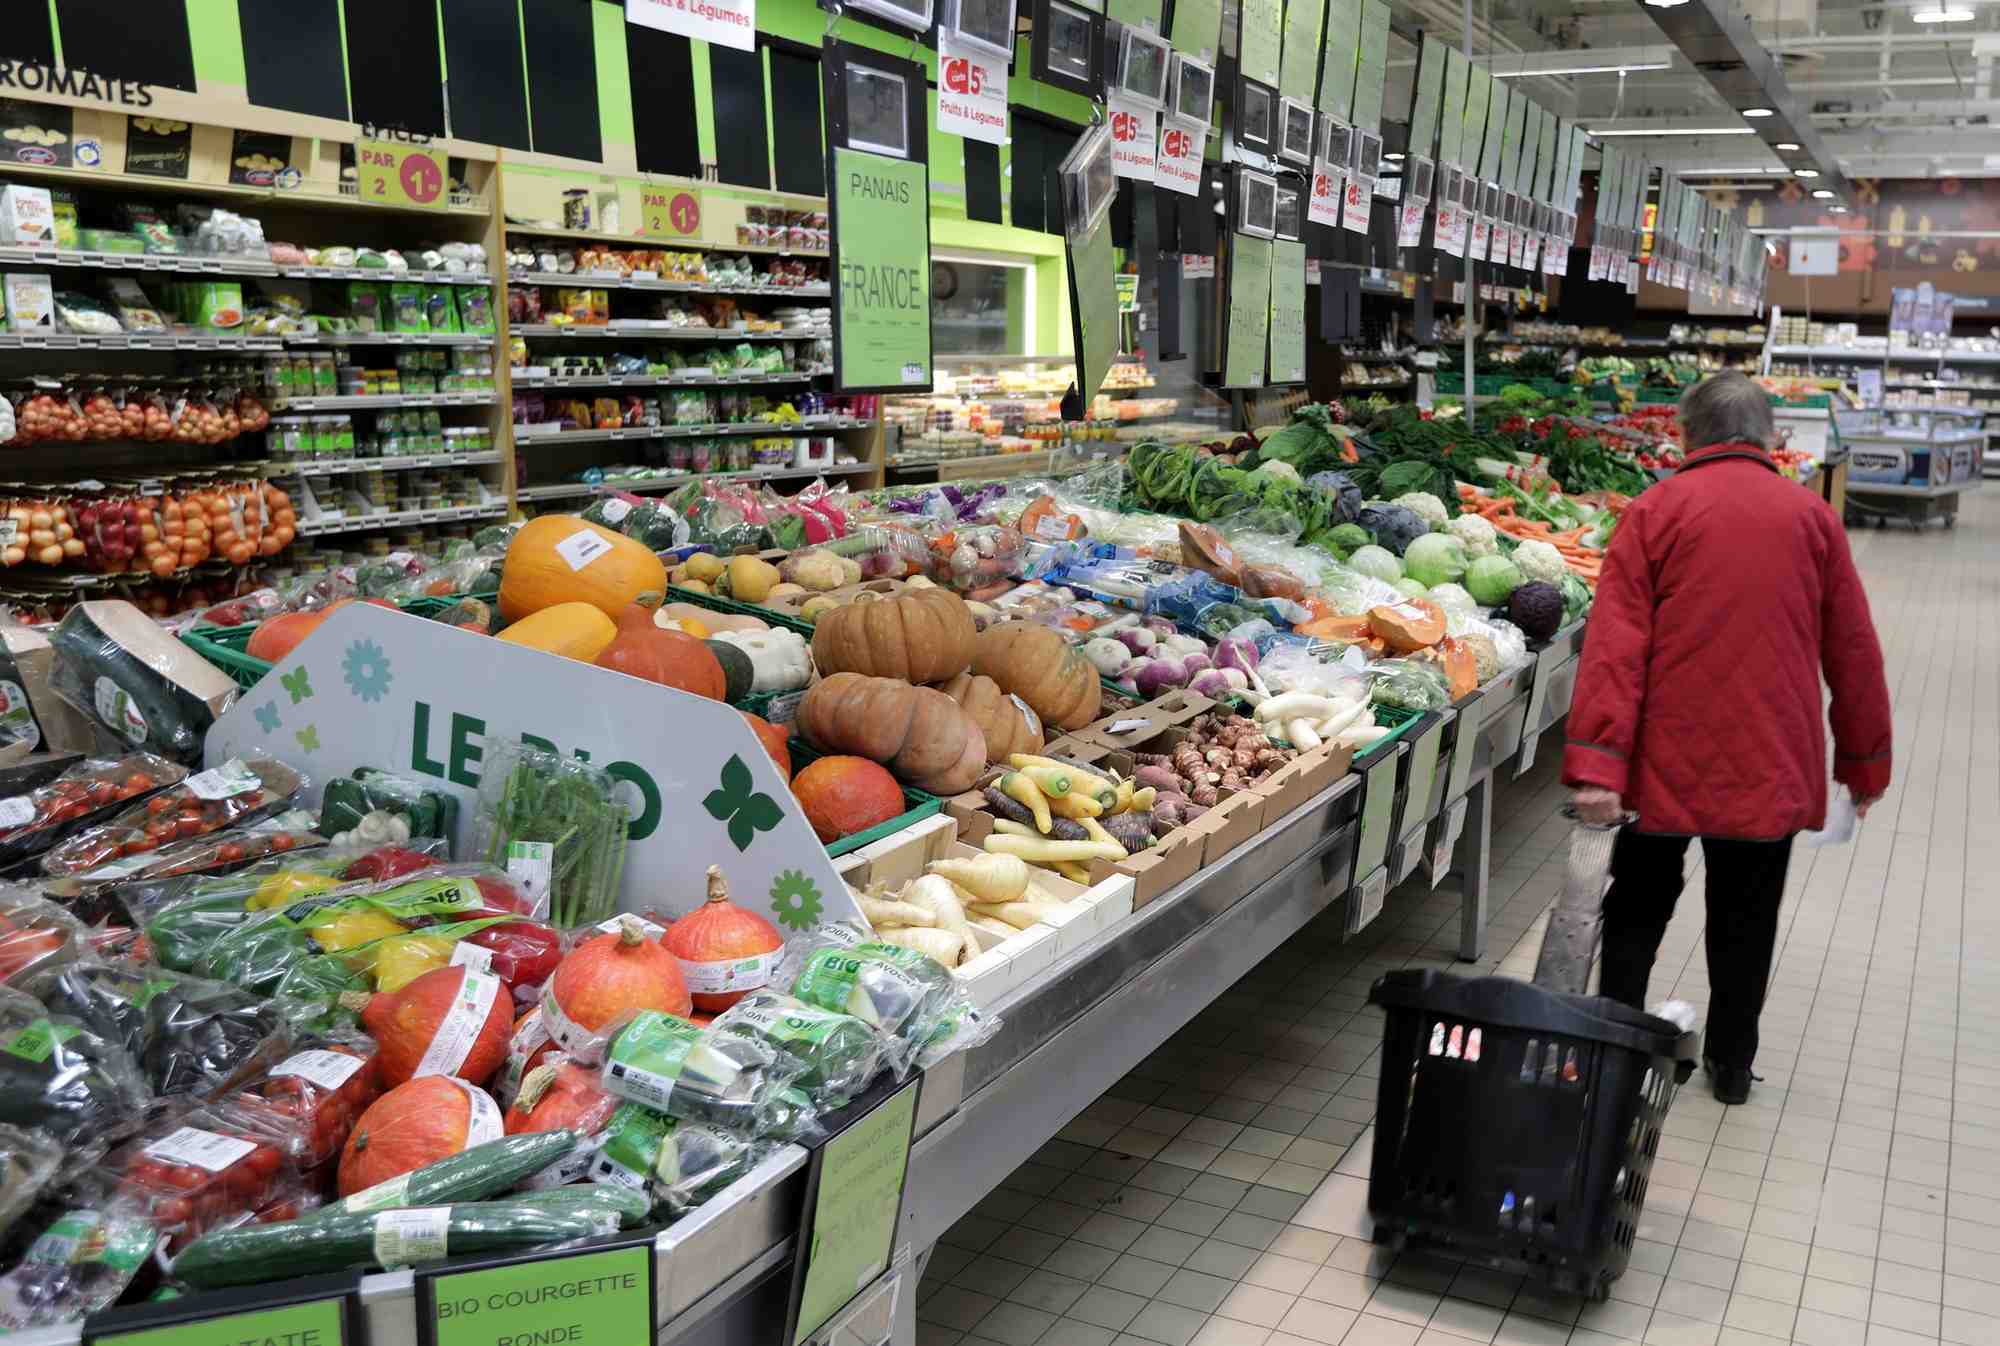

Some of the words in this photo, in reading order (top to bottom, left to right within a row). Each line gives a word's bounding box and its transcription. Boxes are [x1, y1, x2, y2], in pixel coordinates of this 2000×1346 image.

[361, 150, 395, 168] PAR
[374, 176, 386, 195] 2
[850, 172, 910, 204] PANAIS
[643, 194, 667, 207] PAR
[653, 216, 661, 230] 2
[840, 260, 922, 310] FRANCE
[411, 700, 486, 789] LE
[438, 1298, 480, 1319] BIO
[487, 1273, 638, 1311] COURGETTE
[497, 1323, 583, 1346] RONDE
